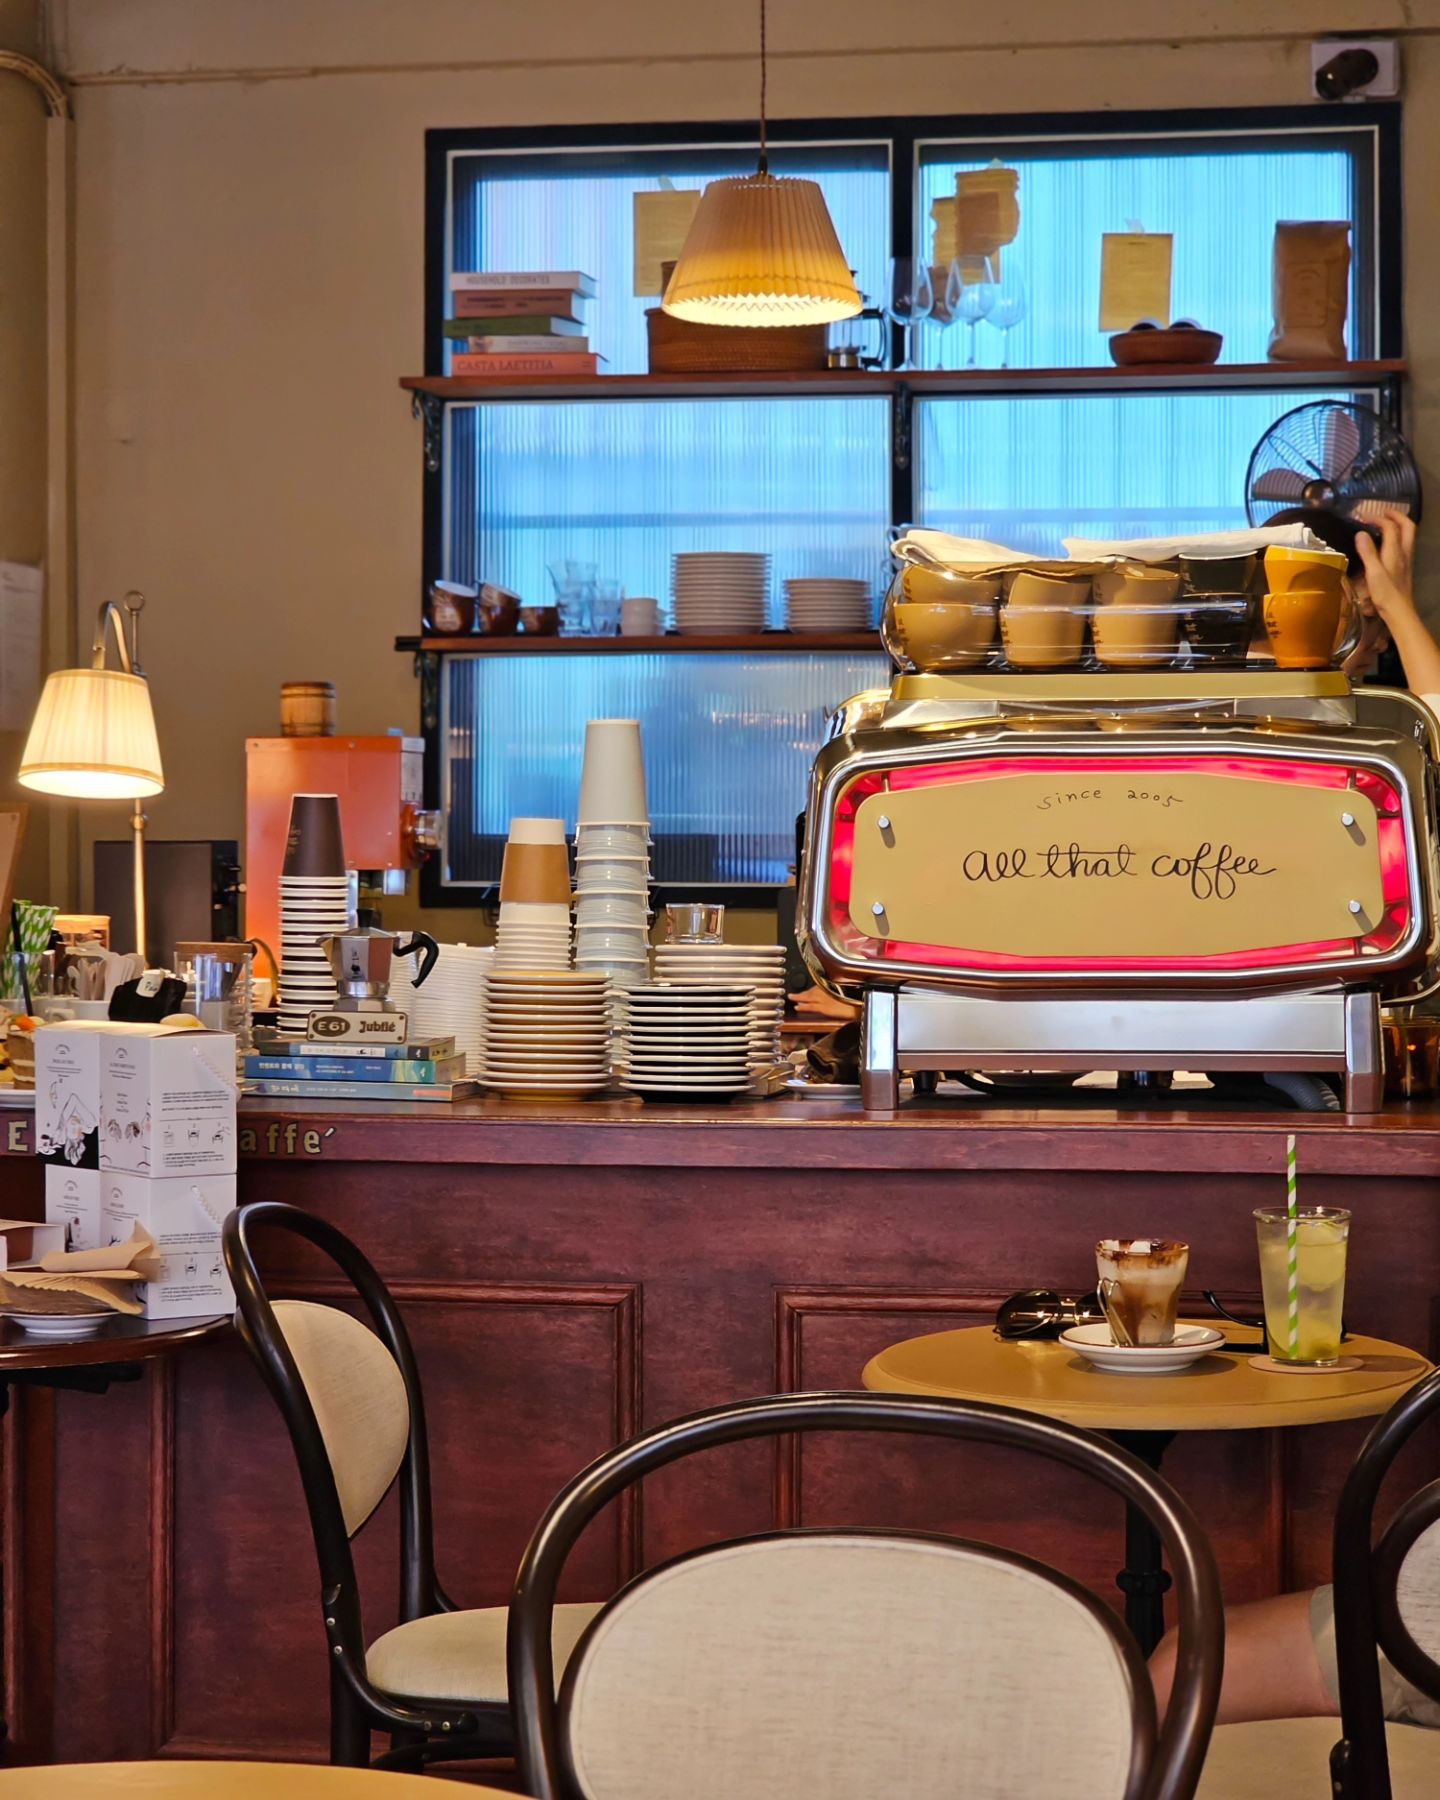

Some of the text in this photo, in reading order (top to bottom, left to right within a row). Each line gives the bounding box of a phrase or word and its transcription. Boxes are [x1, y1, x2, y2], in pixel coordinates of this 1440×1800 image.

[1036, 788, 1184, 810] since 2005
[1036, 842, 1137, 879] that
[1151, 842, 1278, 900] coffee
[329, 1021, 346, 1032] 61
